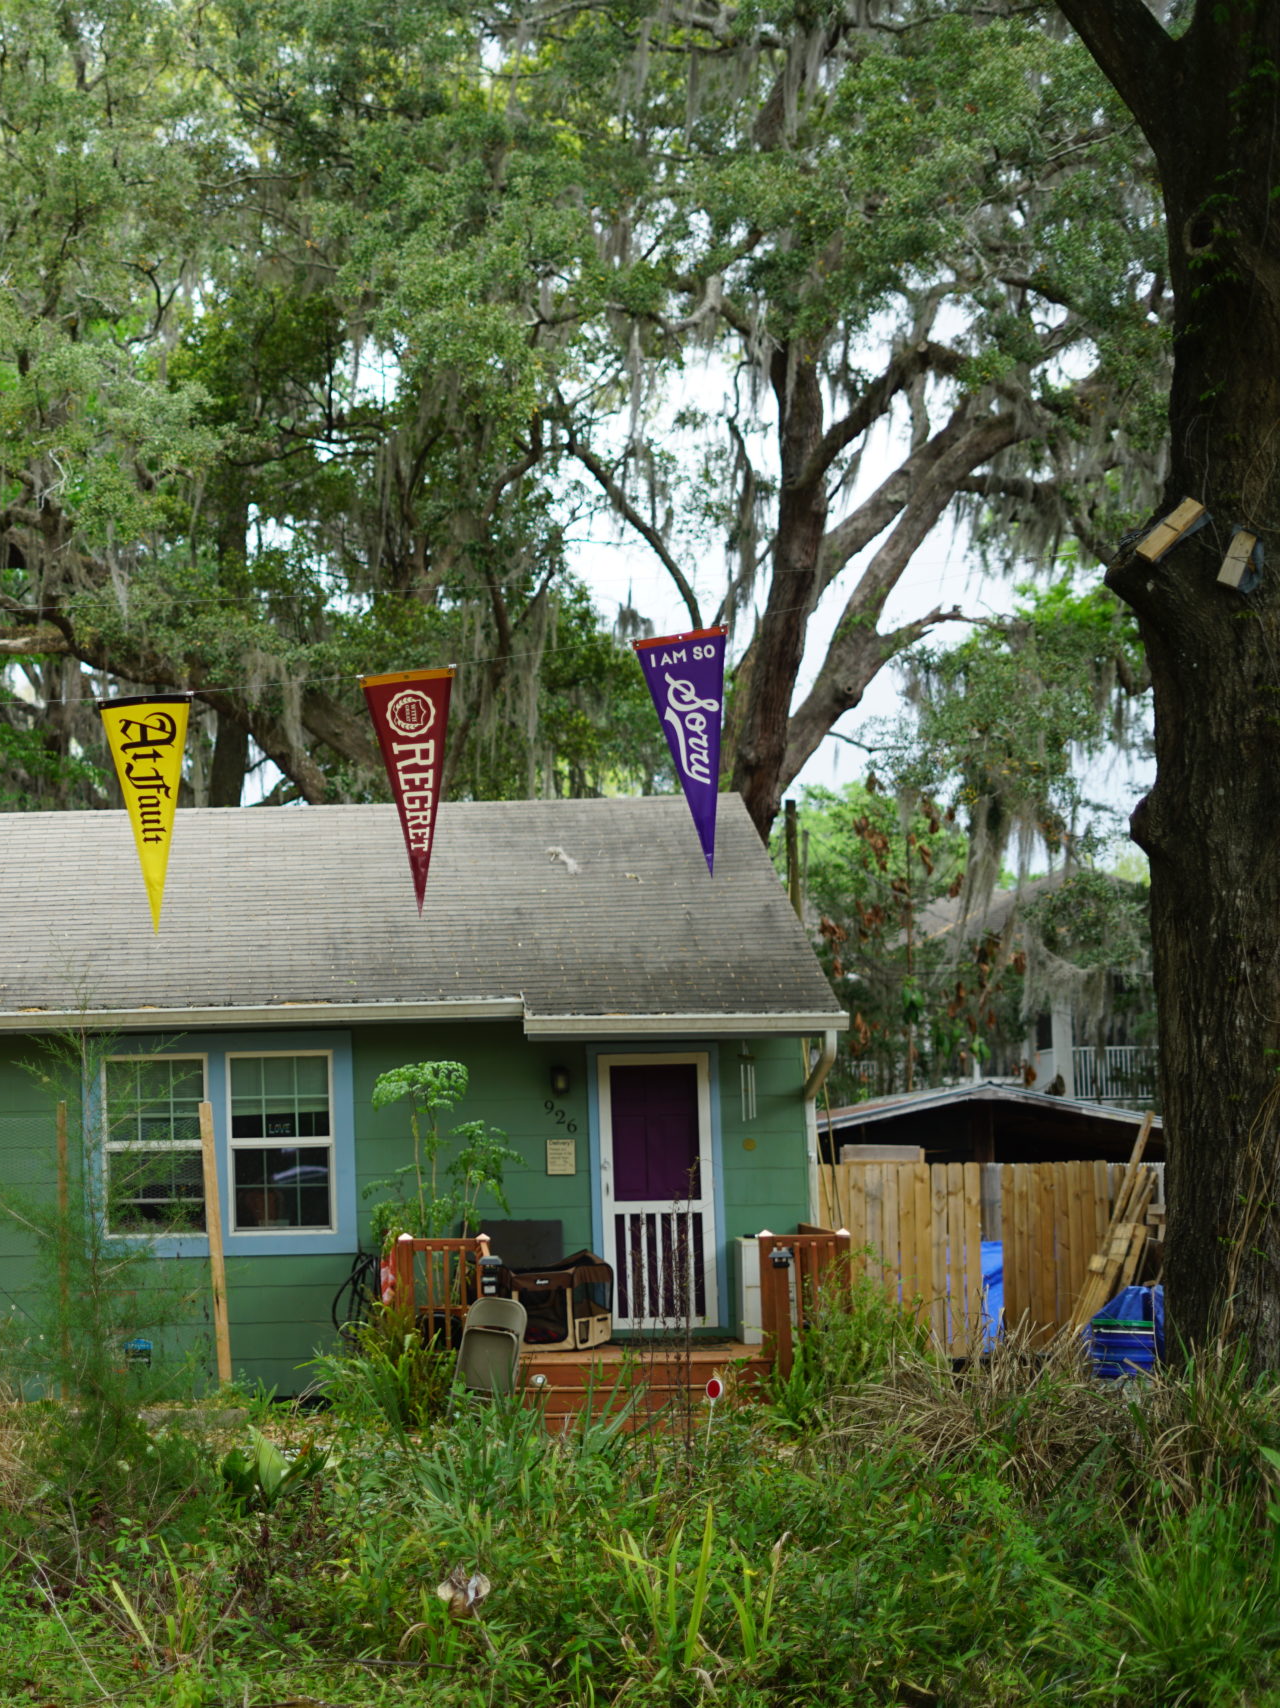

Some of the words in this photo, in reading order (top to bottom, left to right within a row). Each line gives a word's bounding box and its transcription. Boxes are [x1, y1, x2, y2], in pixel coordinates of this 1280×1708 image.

[650, 653, 657, 668] I
[660, 648, 688, 667] AM
[692, 644, 716, 661] SO
[118, 711, 177, 763] At
[663, 671, 720, 785] Sorry
[124, 762, 173, 845] Fault
[391, 738, 436, 853] REGRET
[543, 1099, 578, 1134] 926
